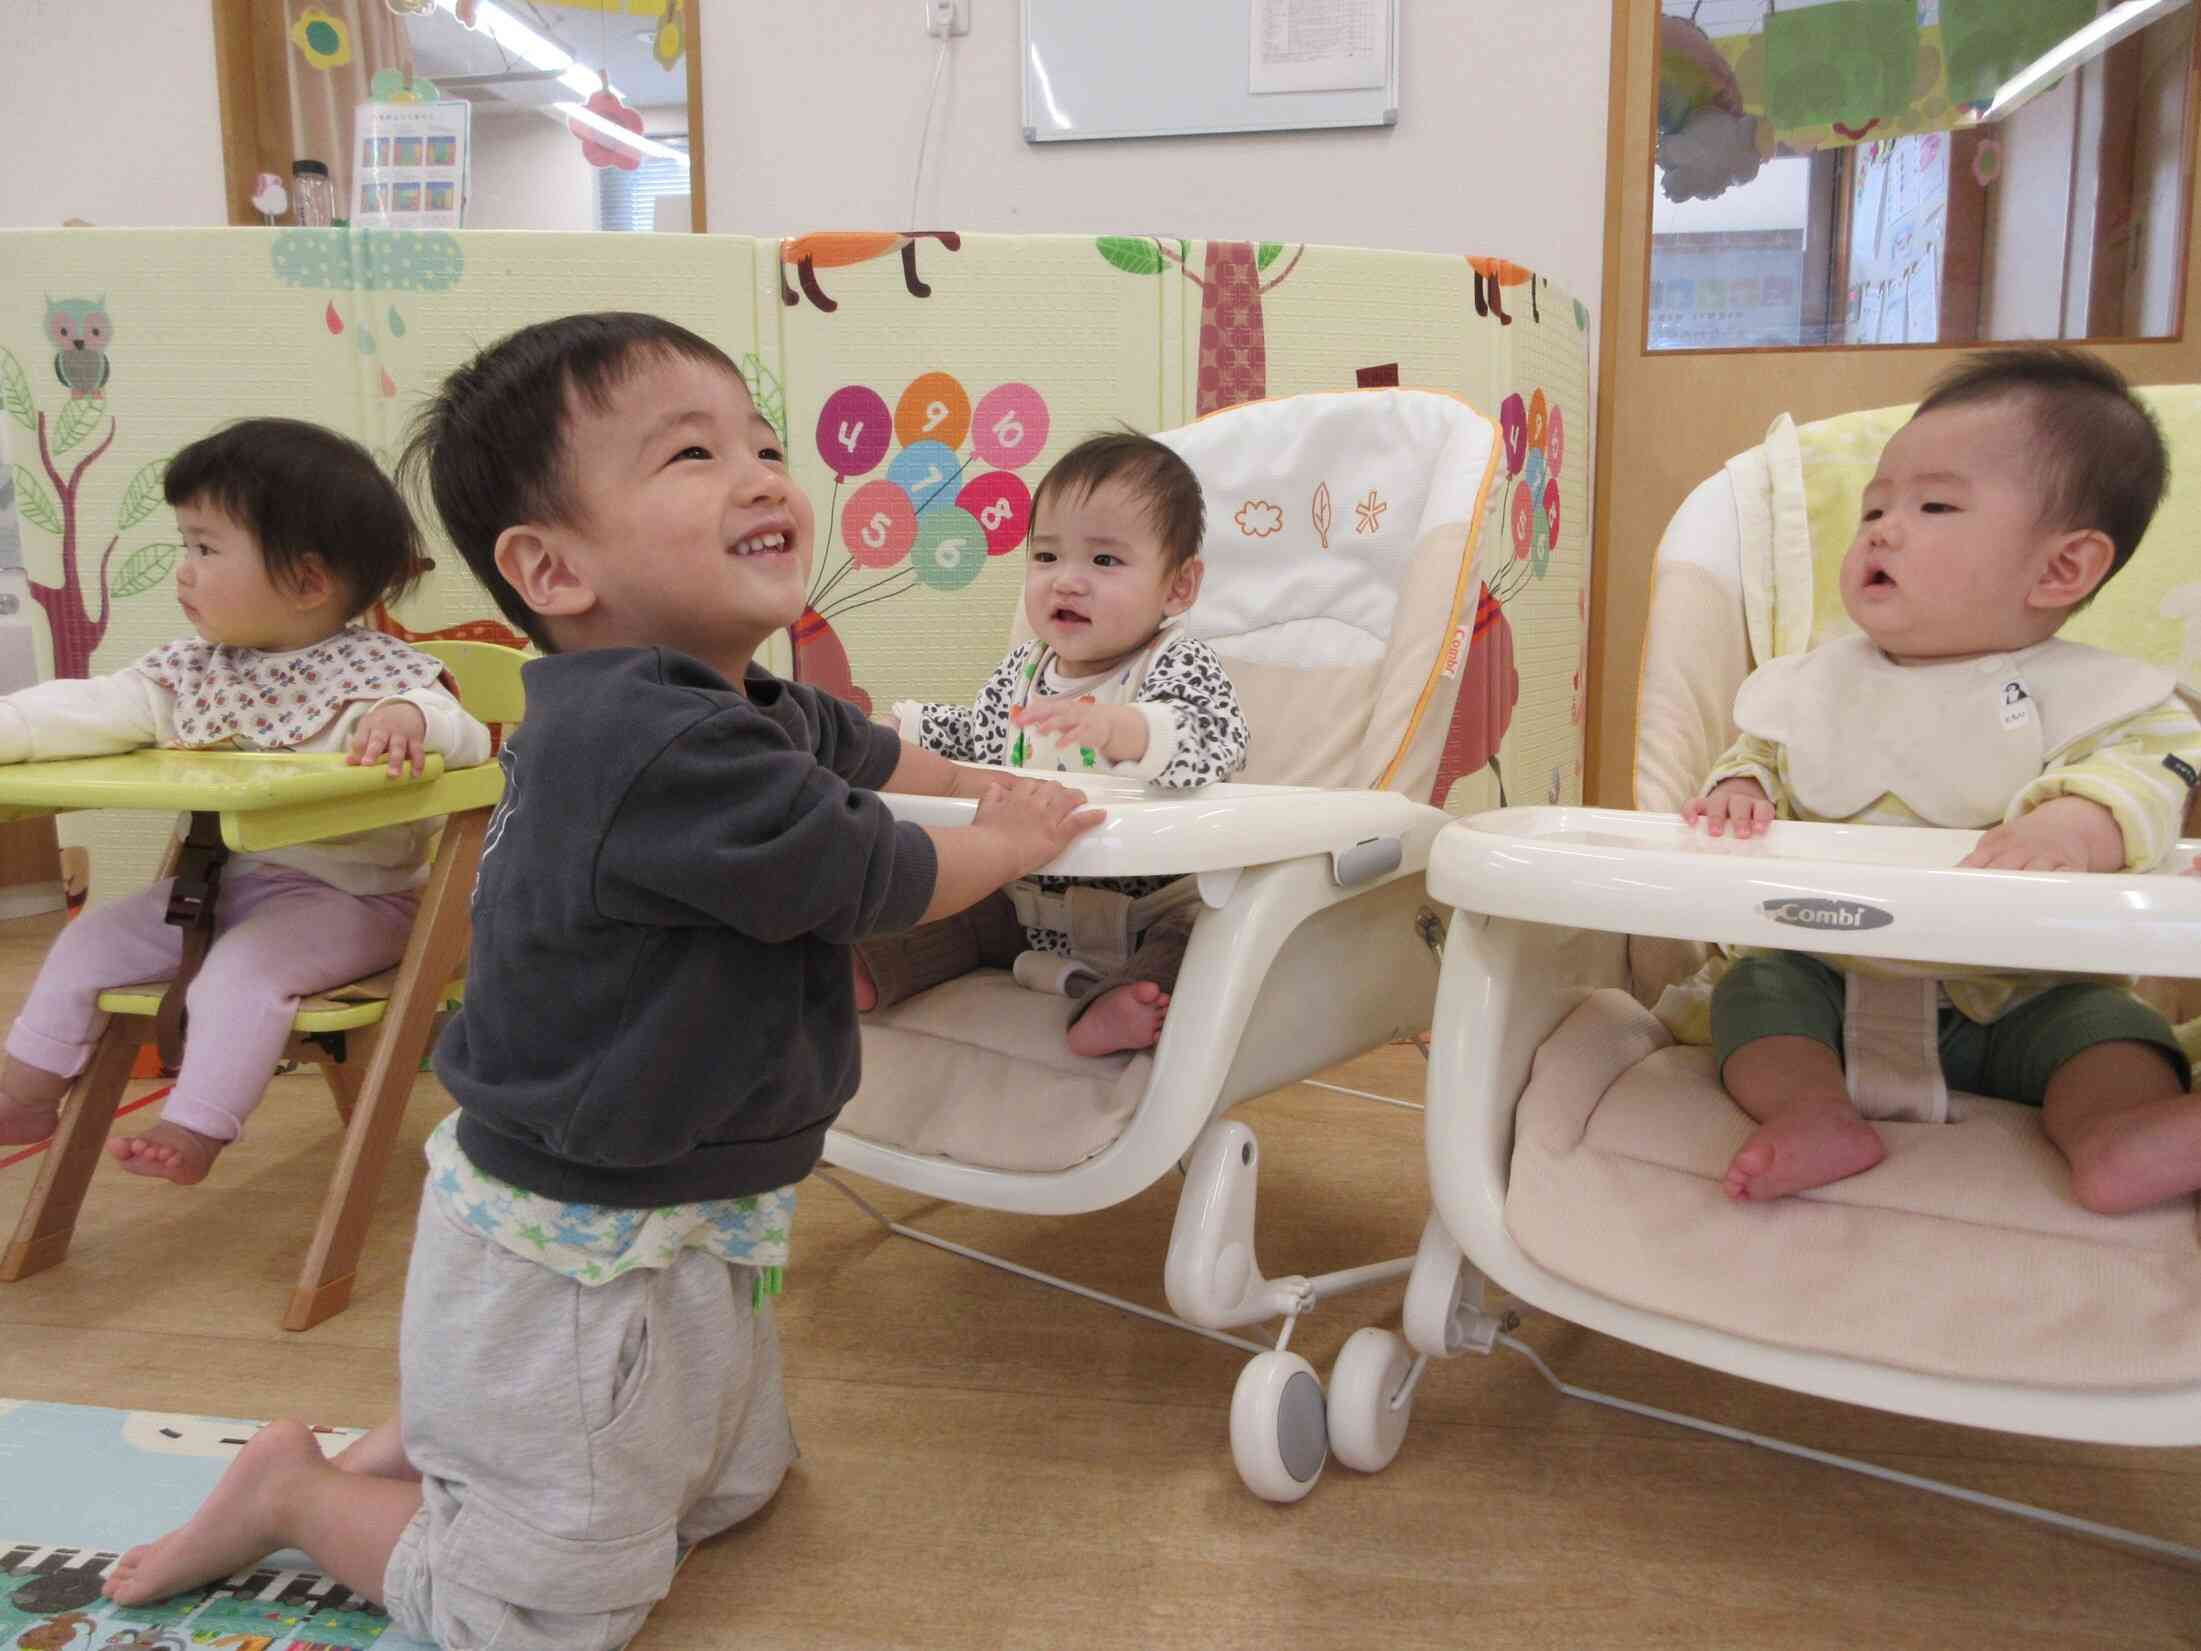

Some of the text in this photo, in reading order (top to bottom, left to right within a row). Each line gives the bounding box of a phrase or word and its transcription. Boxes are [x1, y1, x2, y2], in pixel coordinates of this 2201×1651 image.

[922, 400, 949, 432] 9
[838, 421, 864, 453] 4
[1510, 424, 1520, 454] 4
[861, 512, 892, 548] 5
[980, 497, 1014, 531] 8
[935, 538, 968, 569] 6
[1446, 629, 1465, 675] Combi
[1780, 903, 1865, 927] Combi
